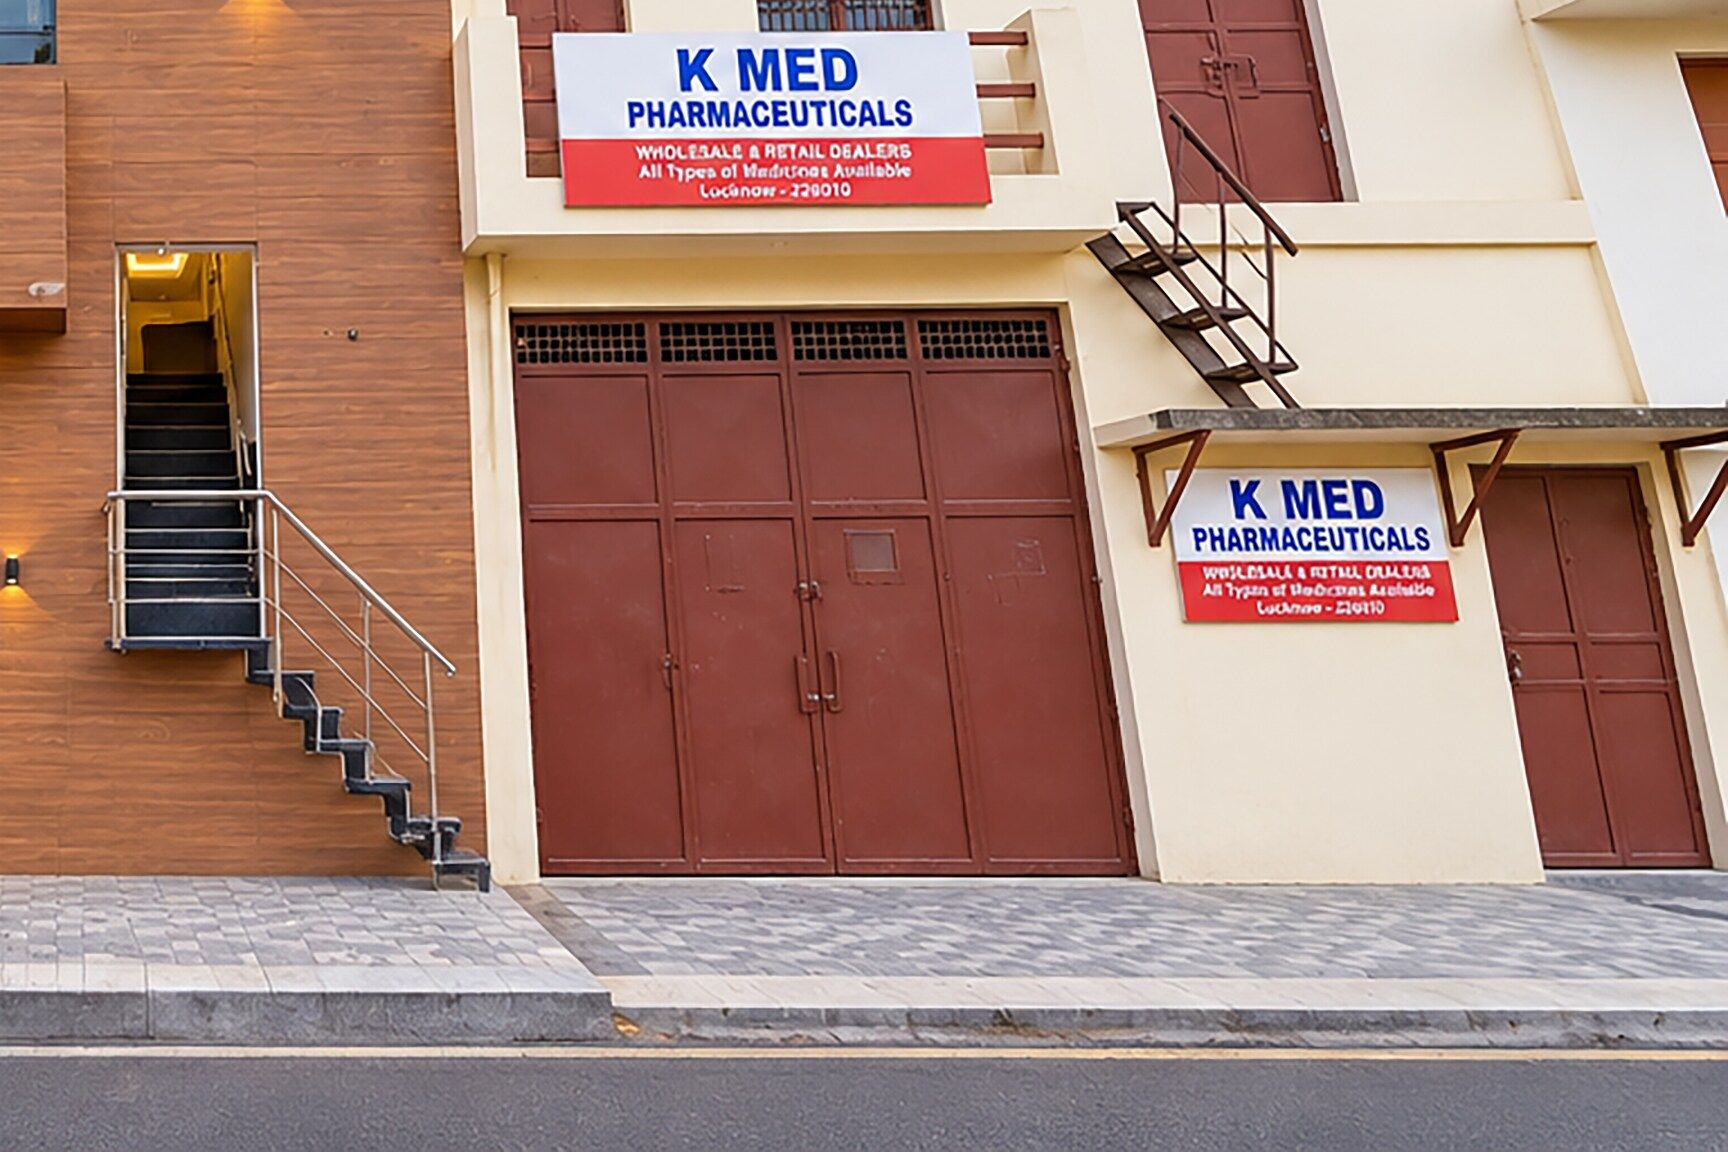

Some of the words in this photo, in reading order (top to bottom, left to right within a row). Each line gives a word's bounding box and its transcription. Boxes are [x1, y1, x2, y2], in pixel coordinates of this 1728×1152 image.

[676, 47, 718, 93] K
[736, 47, 859, 93] MED
[626, 98, 914, 130] PHARMACEUTICALS
[639, 163, 663, 179] All
[1230, 480, 1266, 521] K
[1281, 479, 1385, 521] MED
[1191, 526, 1430, 553] PHARMACEUTICALS
